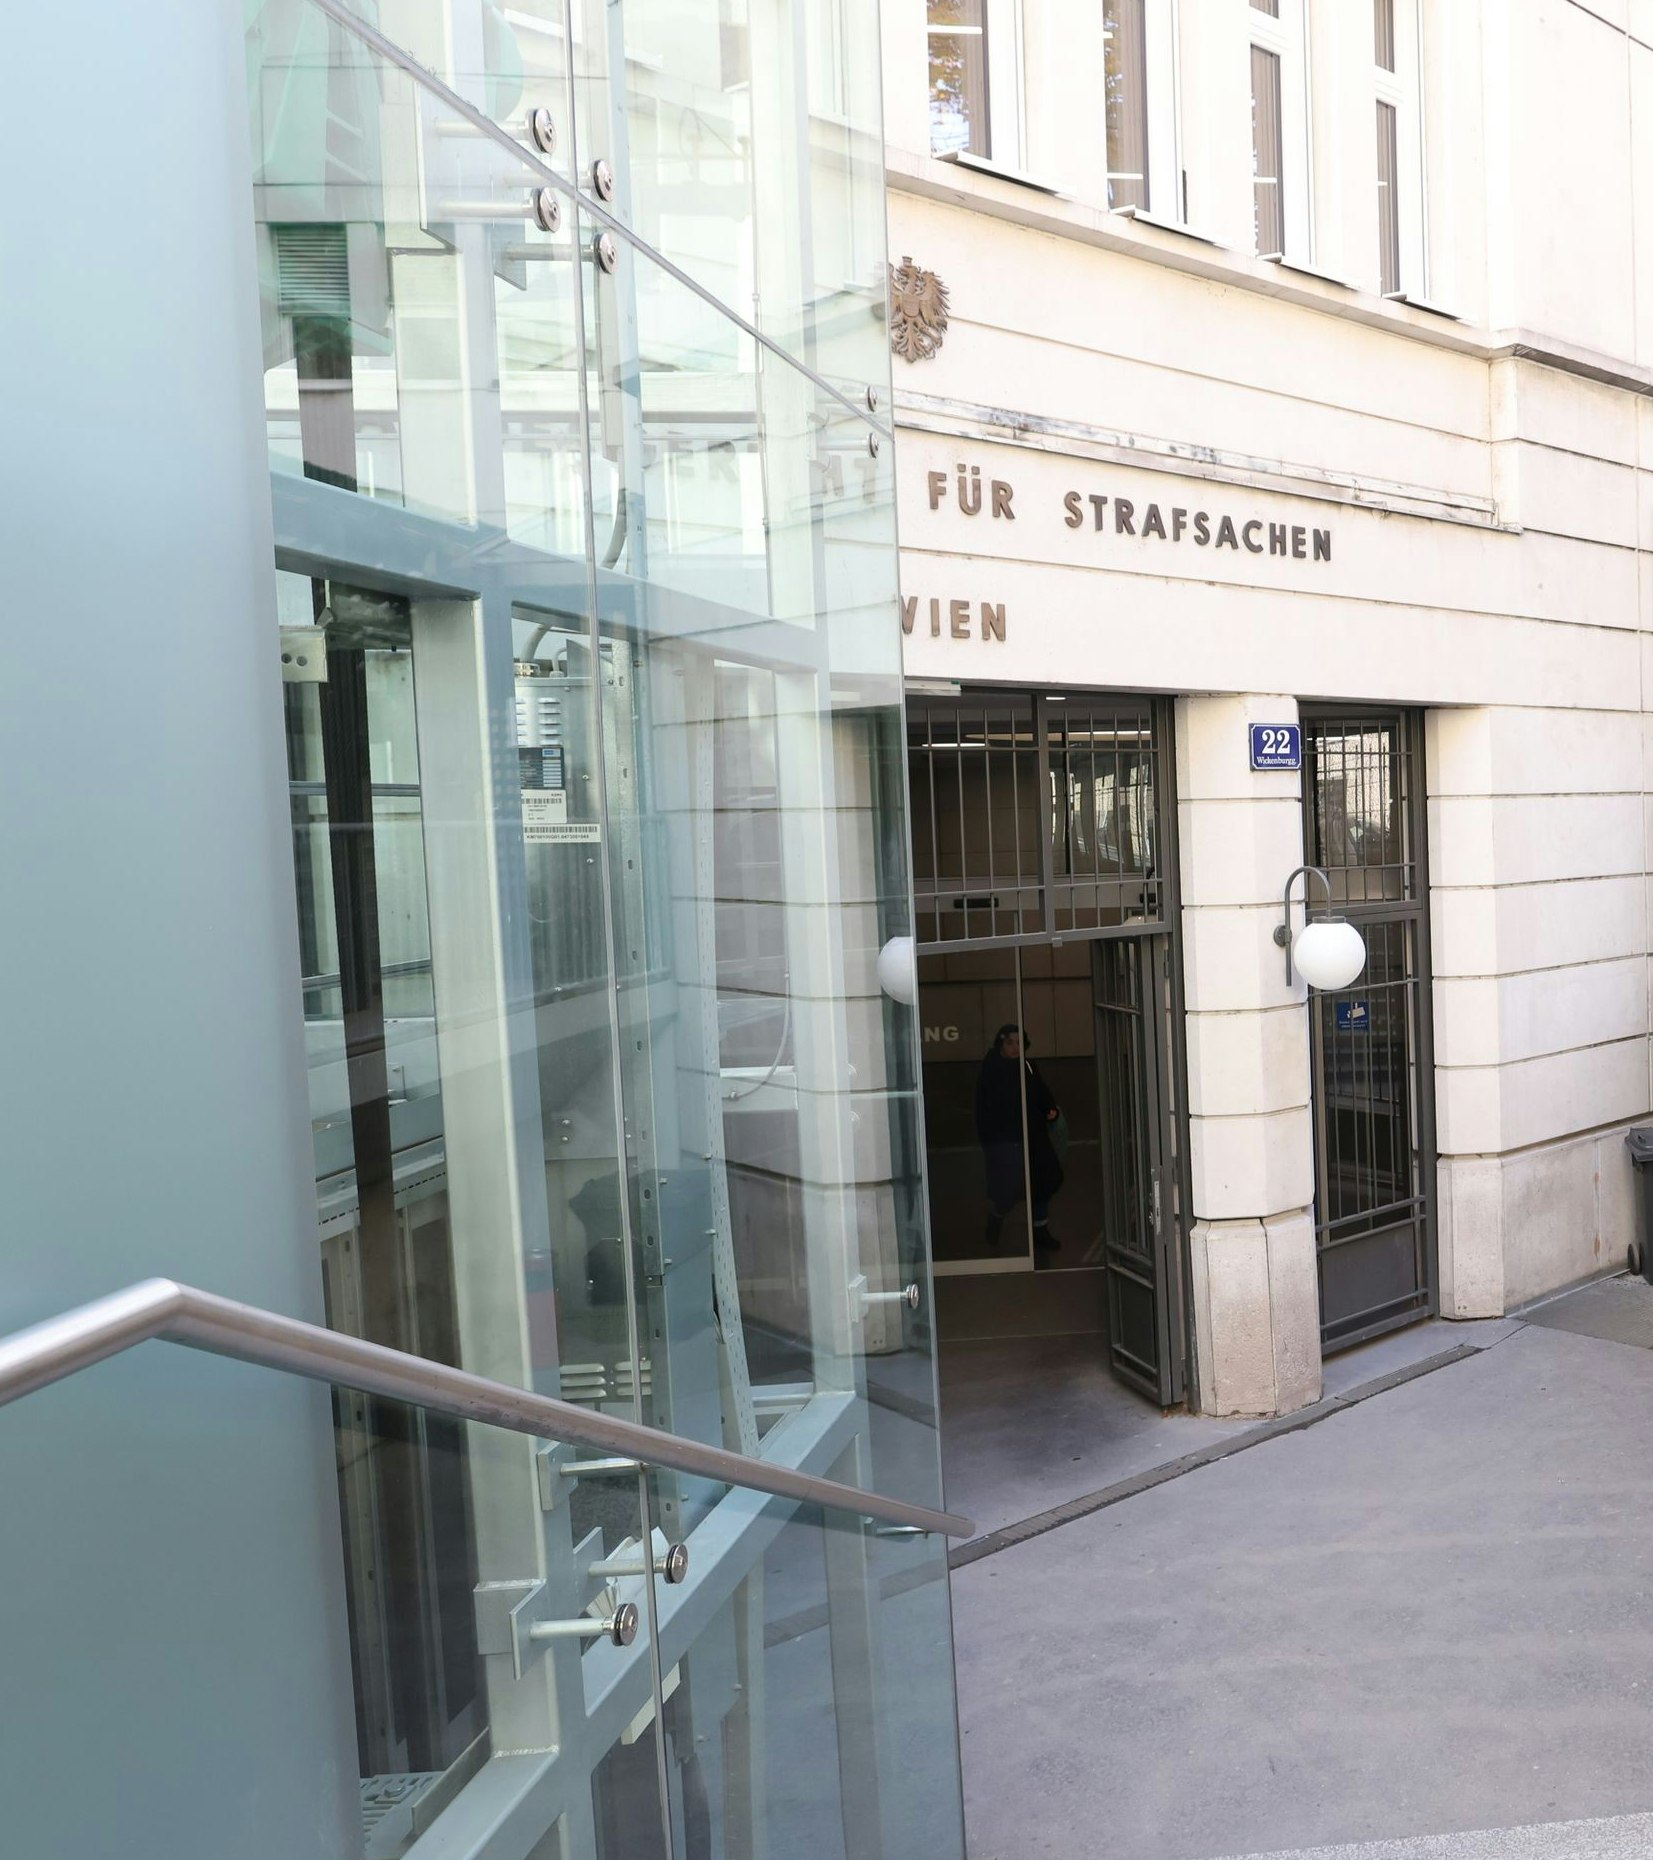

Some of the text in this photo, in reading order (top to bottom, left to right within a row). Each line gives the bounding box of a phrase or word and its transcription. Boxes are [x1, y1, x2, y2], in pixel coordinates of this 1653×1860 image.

[927, 463, 1332, 562] FÜR STRAFSACHEN
[1261, 729, 1290, 754] 22
